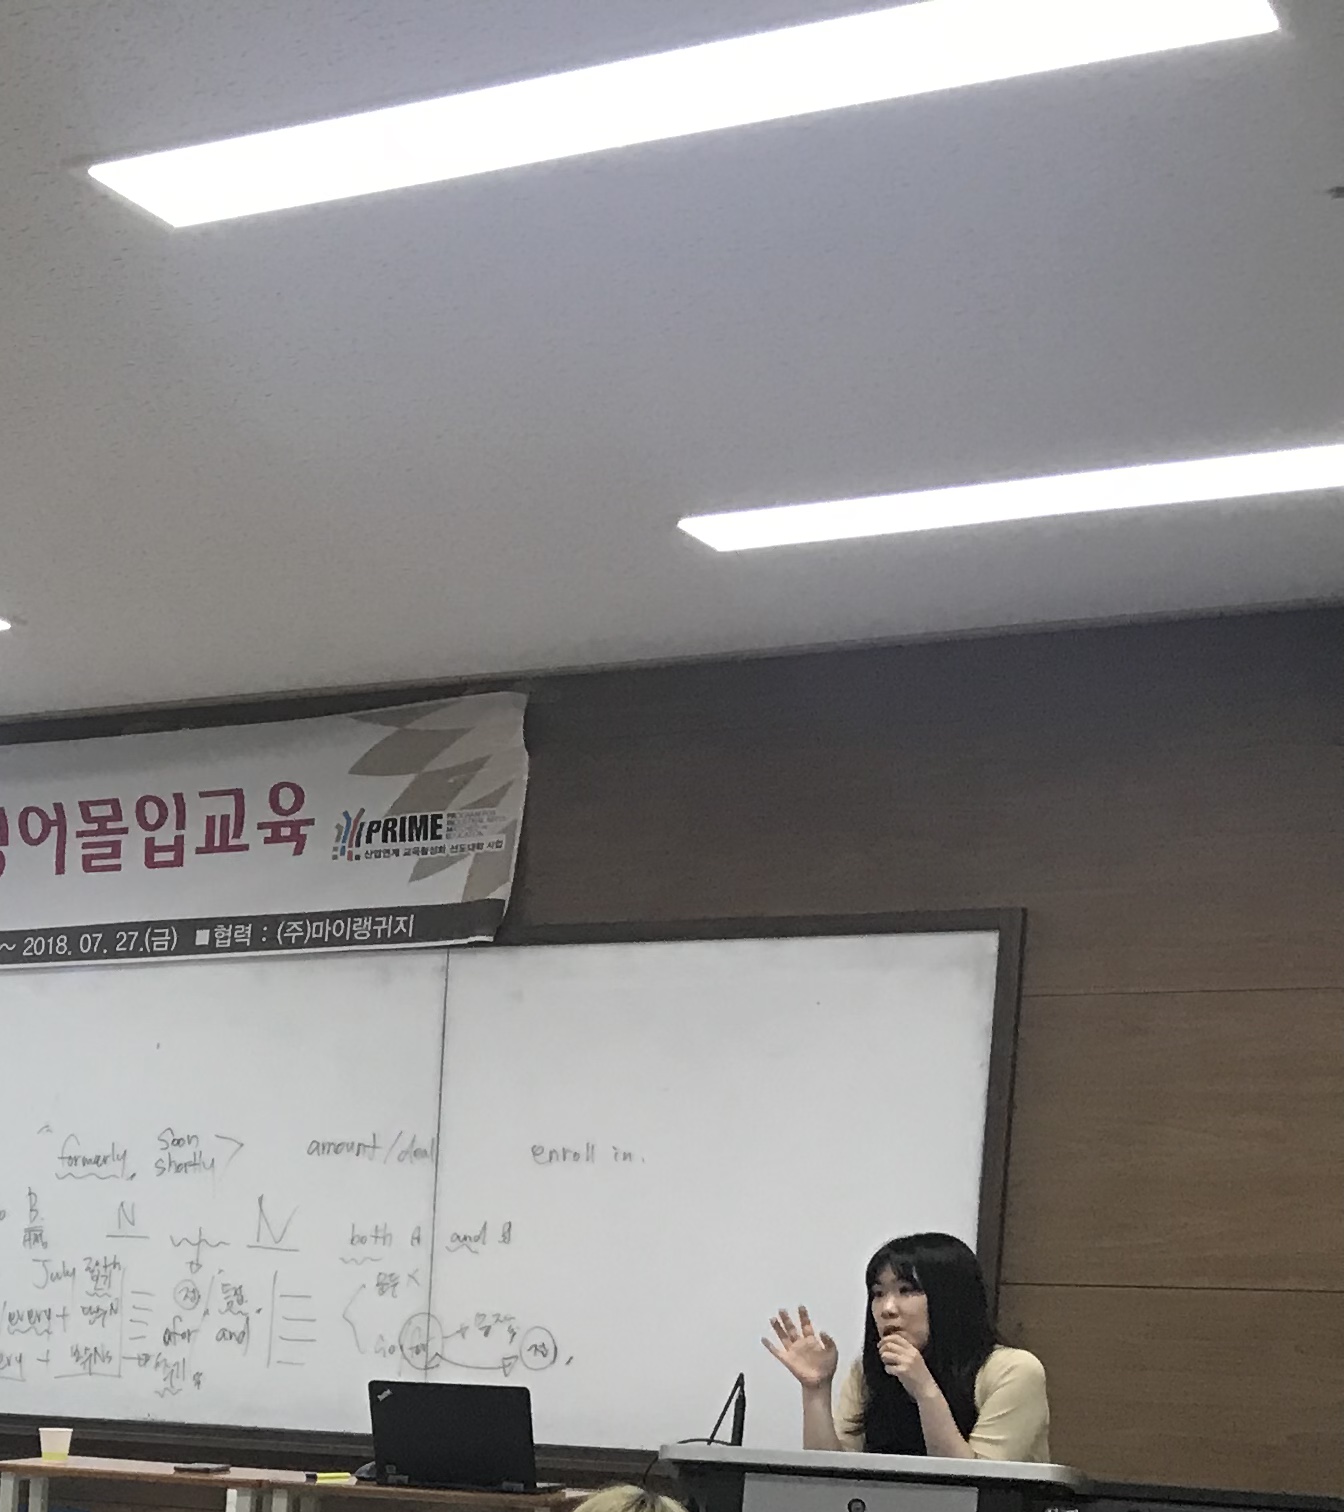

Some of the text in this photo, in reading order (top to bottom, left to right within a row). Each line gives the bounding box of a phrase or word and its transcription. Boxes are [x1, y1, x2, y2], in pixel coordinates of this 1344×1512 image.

[365, 813, 444, 845] PRIME
[214, 922, 254, 948] 협력
[277, 913, 414, 946] (주)마이랭귀지
[22, 933, 73, 957] 2018.
[79, 932, 108, 955] 07.
[531, 1142, 596, 1165] enroll
[350, 1222, 394, 1247] both
[450, 1221, 488, 1246] and
